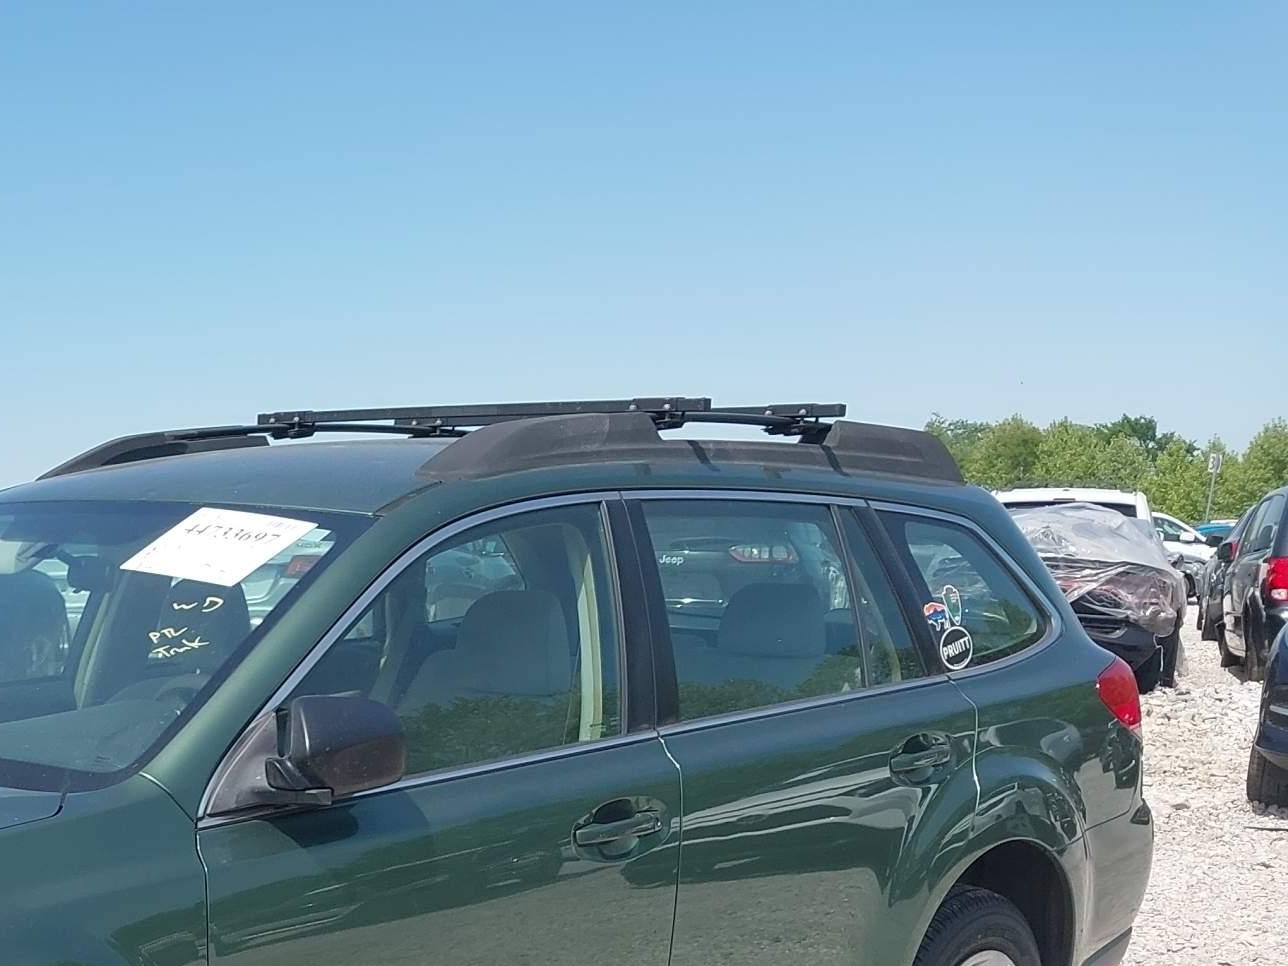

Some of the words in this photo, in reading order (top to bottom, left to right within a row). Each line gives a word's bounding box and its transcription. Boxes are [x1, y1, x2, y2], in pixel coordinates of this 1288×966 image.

[184, 523, 282, 543] 44733697
[659, 554, 684, 566] Jeep
[942, 637, 970, 660] PRUITT
